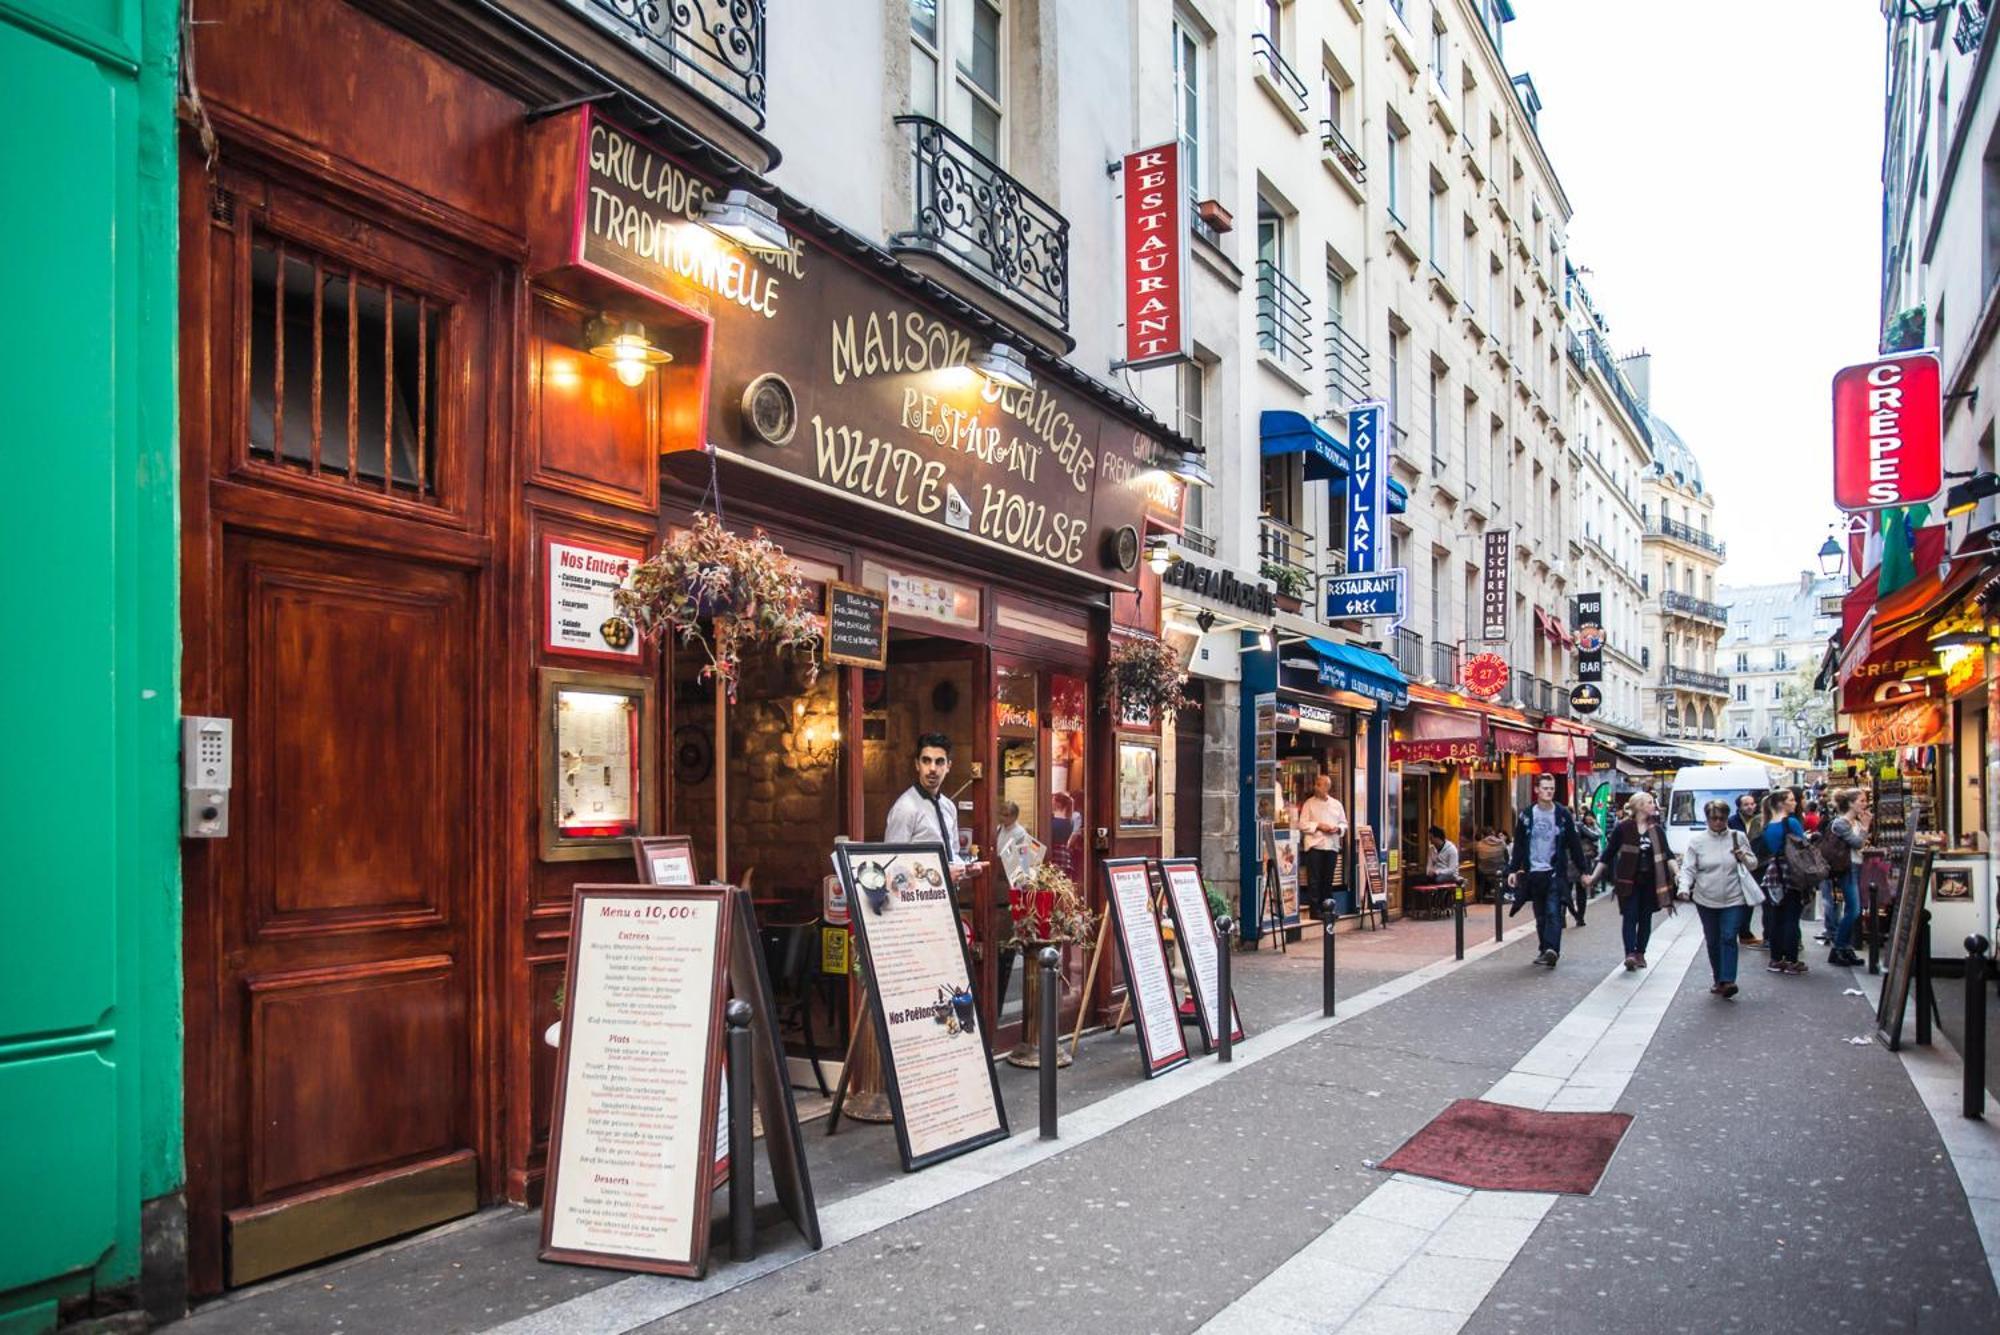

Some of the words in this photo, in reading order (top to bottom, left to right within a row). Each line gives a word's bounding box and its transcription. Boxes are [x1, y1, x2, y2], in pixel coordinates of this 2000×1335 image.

[1135, 153, 1169, 355] RESTAURANT
[832, 310, 971, 385] MAISON
[901, 387, 1043, 484] RESTAURANT
[811, 414, 946, 515] WHITE
[1354, 412, 1371, 572] SOUVLAKI
[979, 483, 1087, 564] HOUSE
[560, 550, 584, 569] Nos
[1486, 534, 1496, 602] BISTRO
[1328, 577, 1395, 596] RESTAURANT
[1497, 533, 1506, 625] HUCHETTE
[1346, 599, 1376, 614] GREC
[1580, 602, 1600, 613] PUB
[1480, 669, 1492, 680] 27
[1580, 662, 1600, 673] BAR
[1450, 743, 1477, 756] BAR
[600, 907, 630, 918] Menu
[889, 1010, 904, 1025] Nos
[609, 1034, 630, 1044] Plats
[594, 1174, 629, 1185] Desserts
